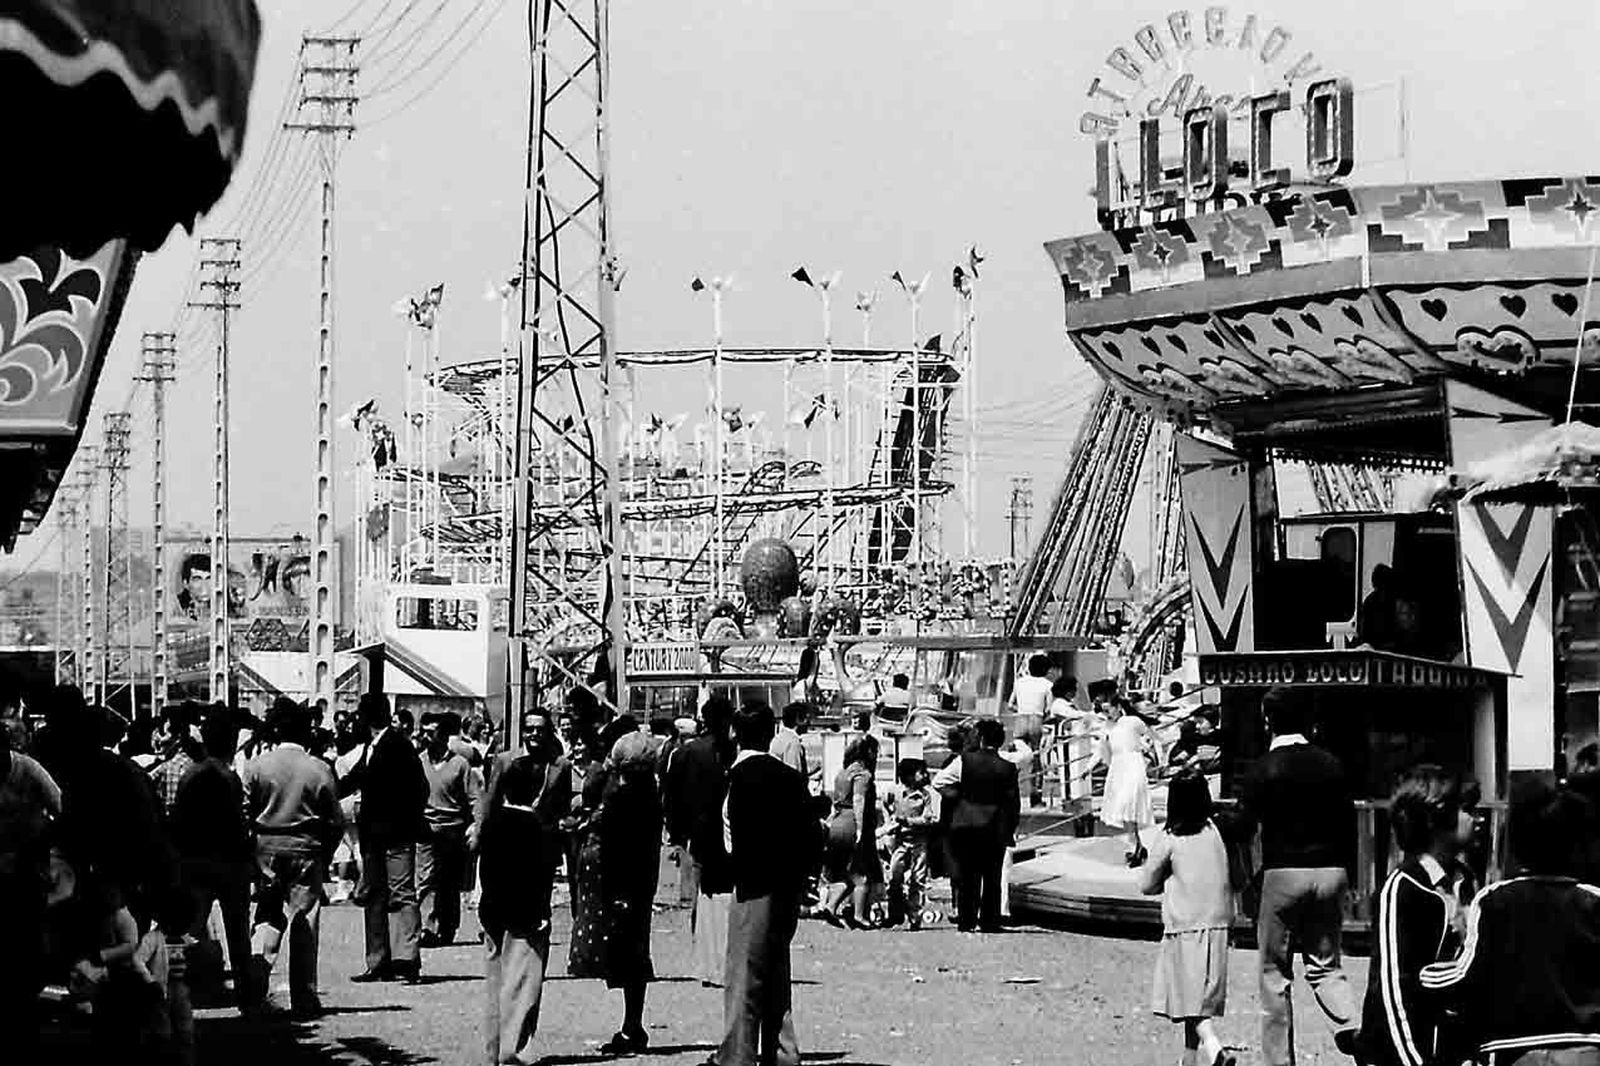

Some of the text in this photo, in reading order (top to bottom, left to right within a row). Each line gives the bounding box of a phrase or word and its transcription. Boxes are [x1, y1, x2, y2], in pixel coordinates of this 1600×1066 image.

[1140, 78, 1354, 208] LOCO
[633, 647, 694, 671] CENTURY 2000
[1305, 659, 1364, 683] LOCO
